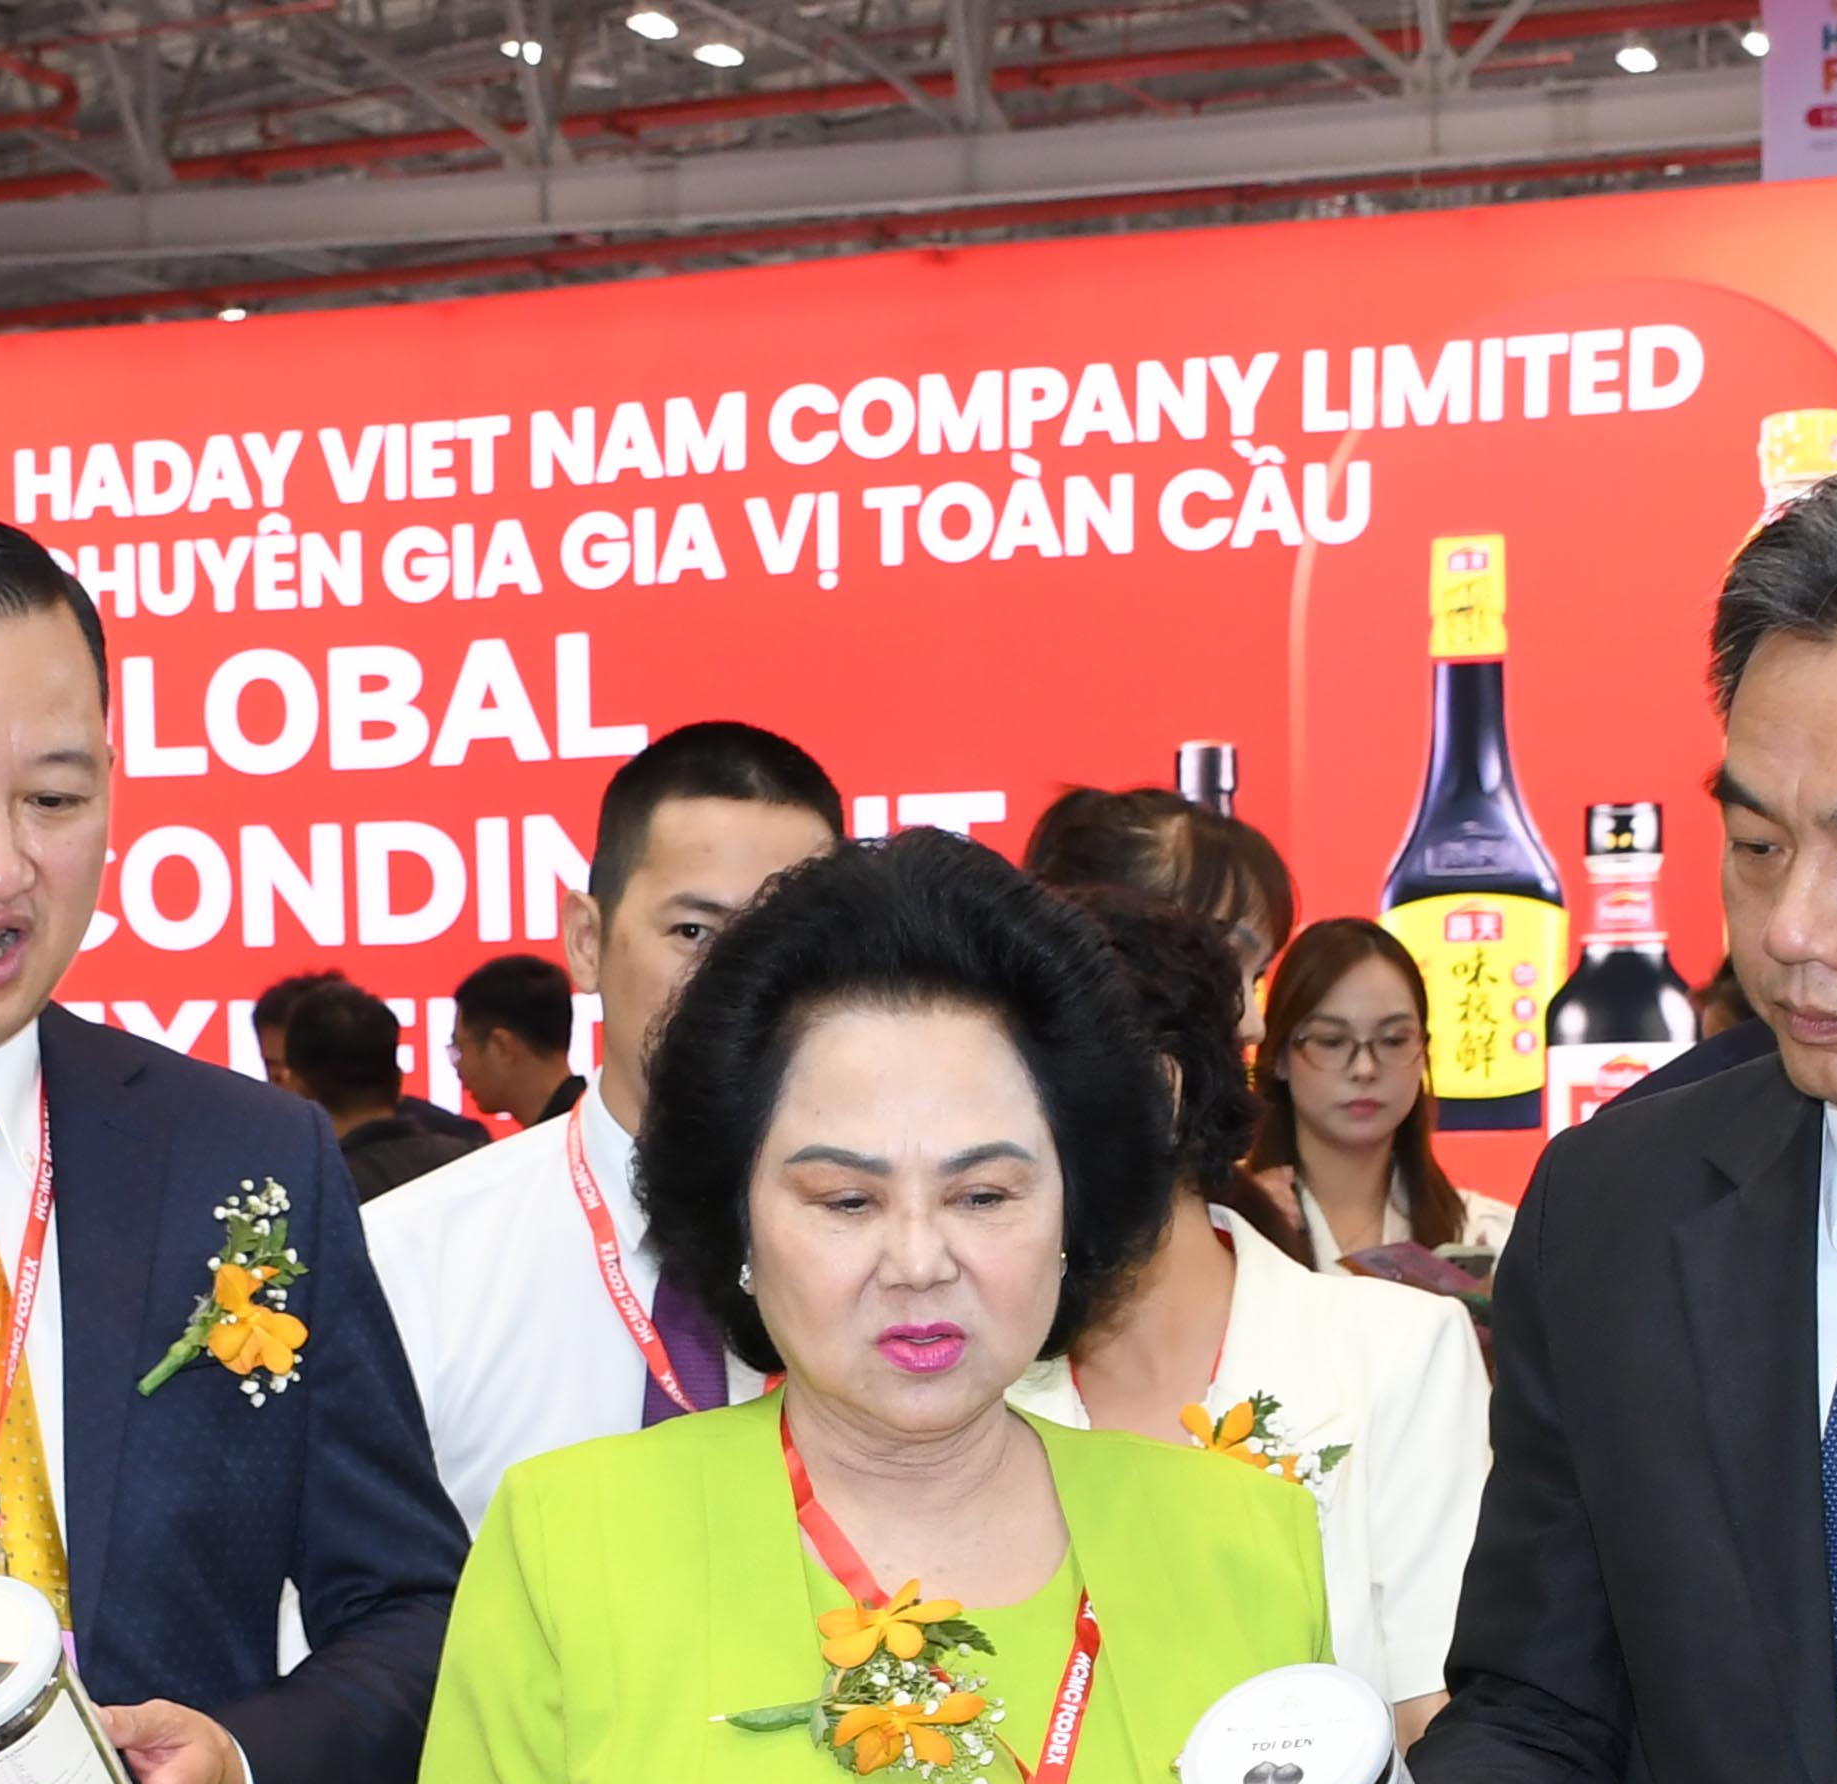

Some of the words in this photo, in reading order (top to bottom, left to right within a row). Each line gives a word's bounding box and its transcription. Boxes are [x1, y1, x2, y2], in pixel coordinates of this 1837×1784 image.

[13, 428, 302, 525] HADAY
[318, 413, 511, 506] VIET
[527, 390, 747, 488] NAM
[767, 350, 1280, 465] COMPANY
[1301, 322, 1704, 435] LIMITED
[380, 520, 541, 606] GIA
[559, 503, 727, 593] GIA
[745, 493, 841, 591] VỊ
[861, 453, 1134, 569] TOÀN
[1158, 439, 1372, 552] CẦU
[119, 630, 648, 780] LOBAL
[34, 1162, 54, 1222] HCMC
[618, 1295, 655, 1344] HCMC
[1063, 1650, 1092, 1704] HCMC
